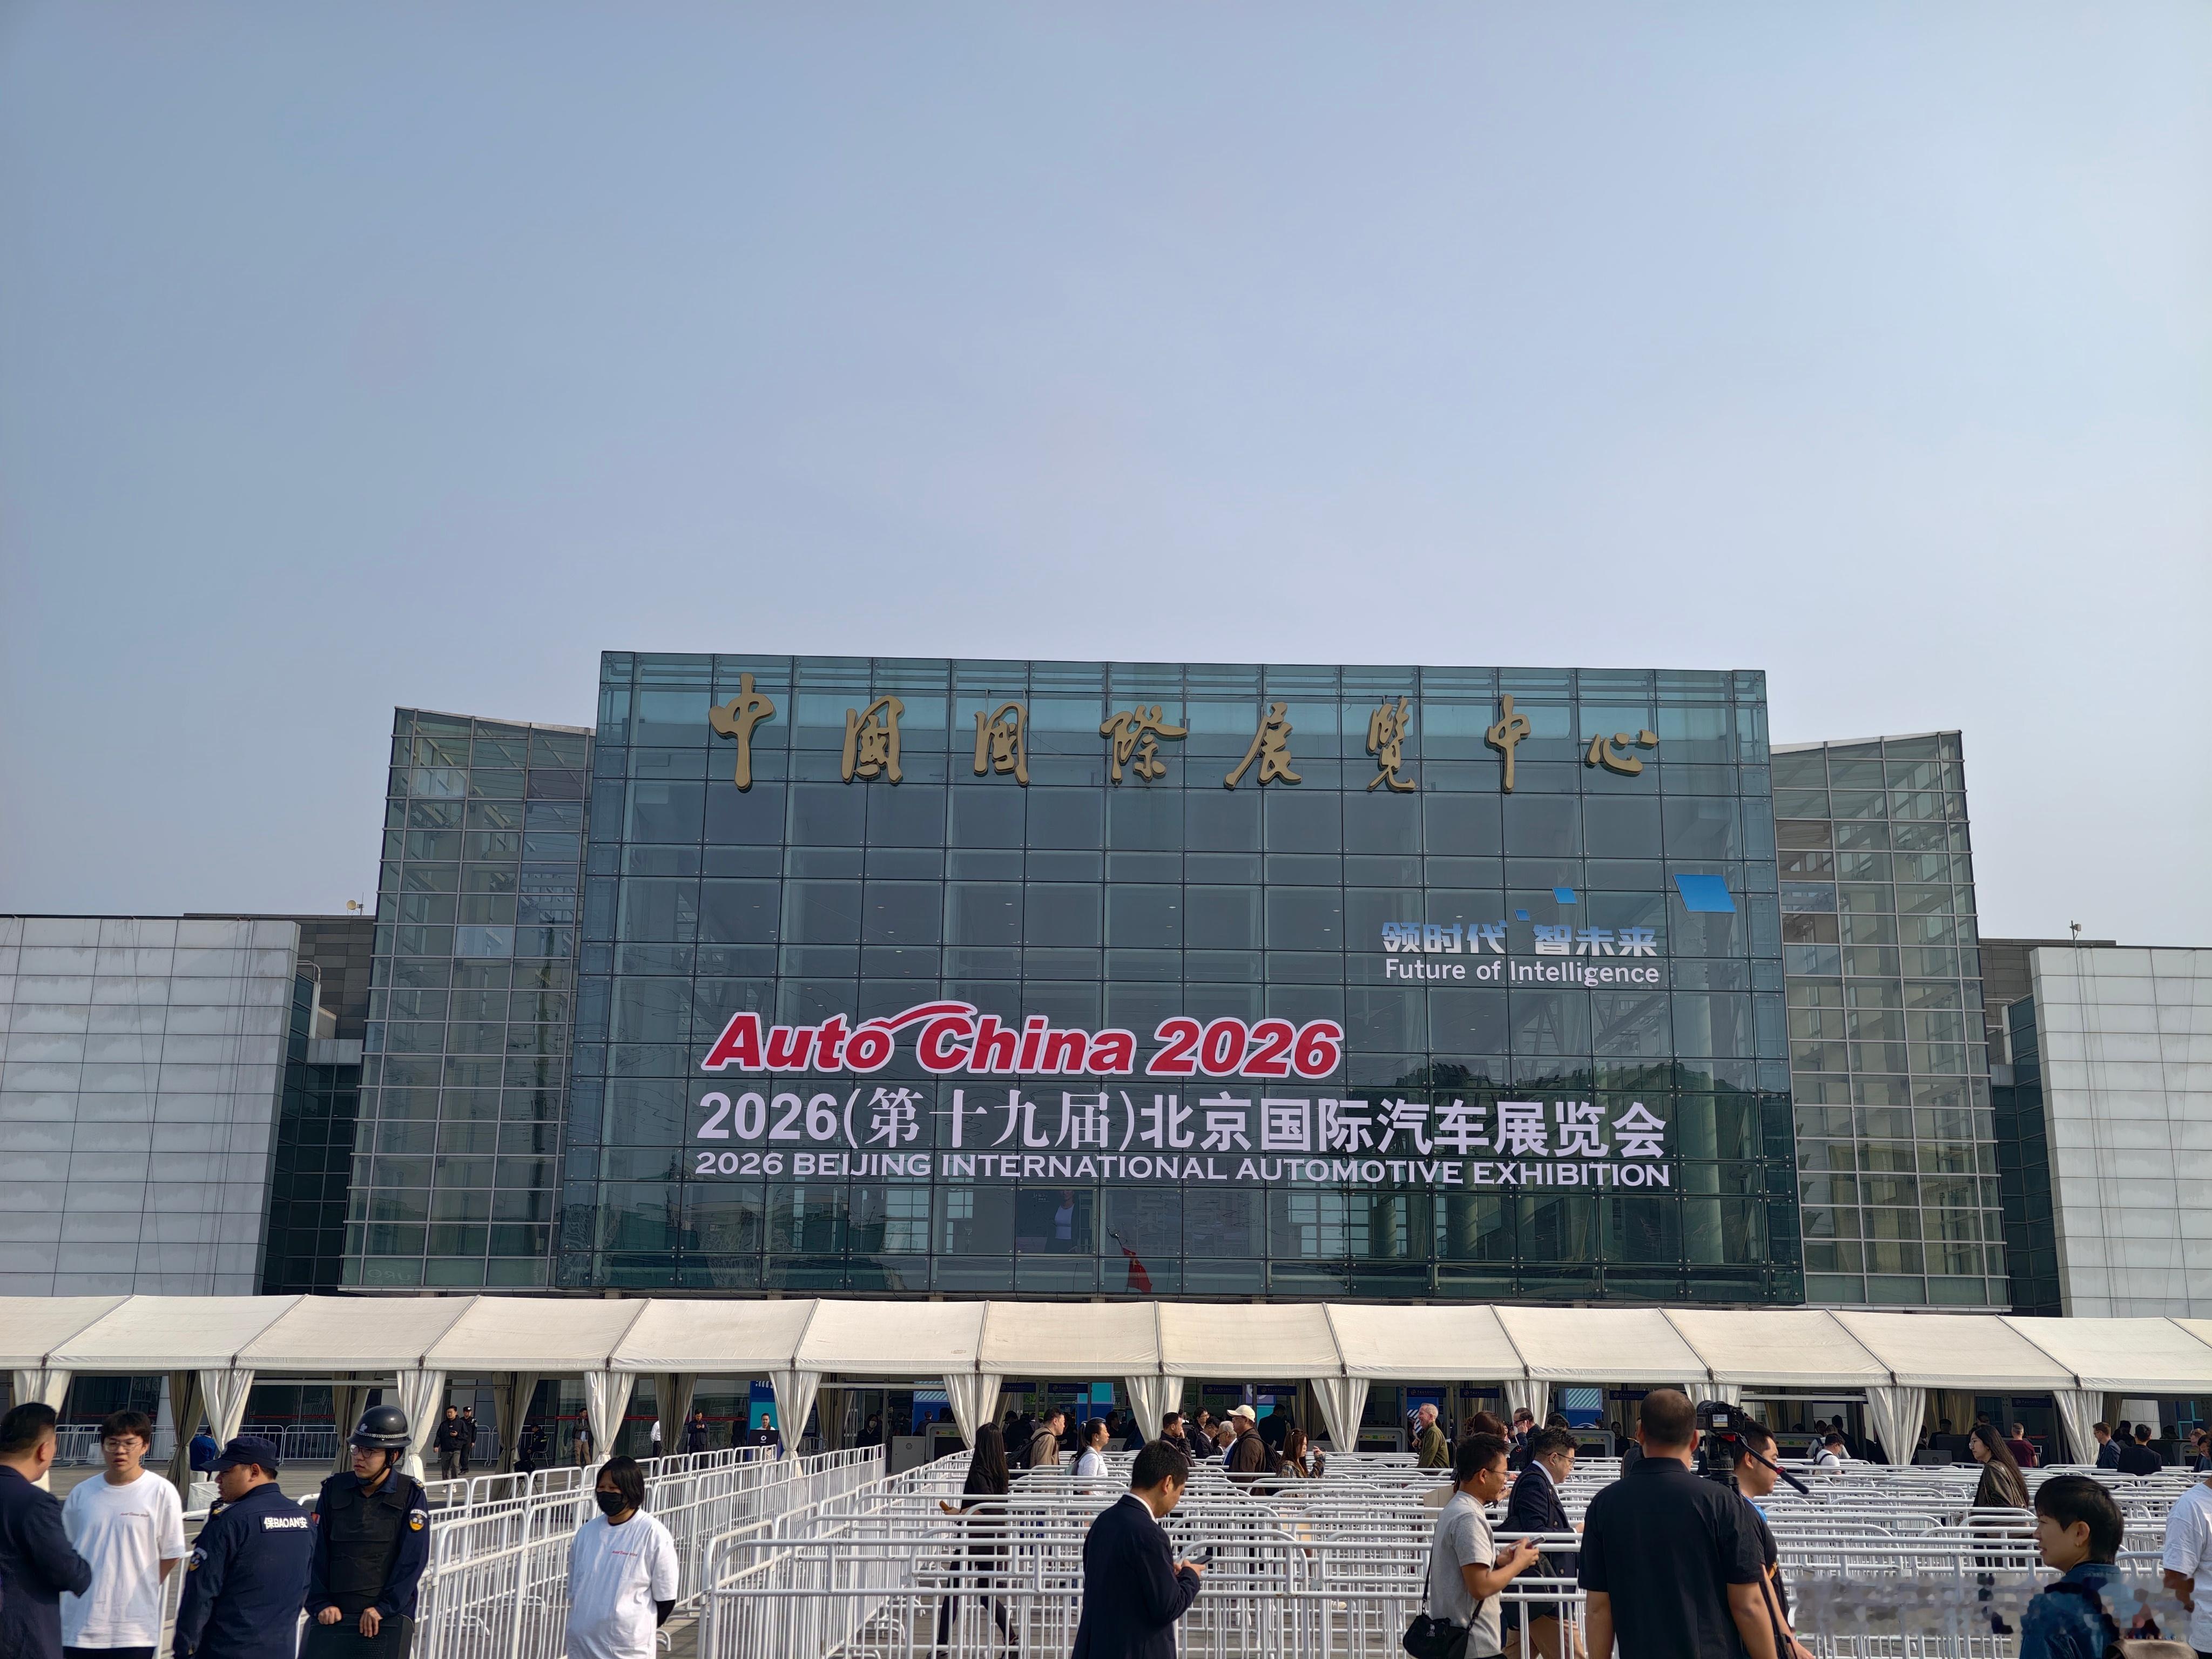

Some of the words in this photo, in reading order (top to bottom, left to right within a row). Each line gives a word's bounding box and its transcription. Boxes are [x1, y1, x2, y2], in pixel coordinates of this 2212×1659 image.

[1381, 920, 1508, 954] 领时代
[1533, 924, 1657, 956] 智未来
[1386, 959, 1466, 981] Future
[1476, 960, 1501, 982] of
[1510, 961, 1659, 987] Intelligence
[701, 1011, 894, 1073] Auto
[916, 1014, 1137, 1075] China
[1145, 1016, 1344, 1079] 2026
[696, 1152, 784, 1176] 2026
[792, 1153, 932, 1176] BEIJING
[941, 1154, 1229, 1181] INTERNATIONAL
[1236, 1157, 1464, 1185] AUTOMOTIVE
[1473, 1162, 1670, 1187] EXHIBITION
